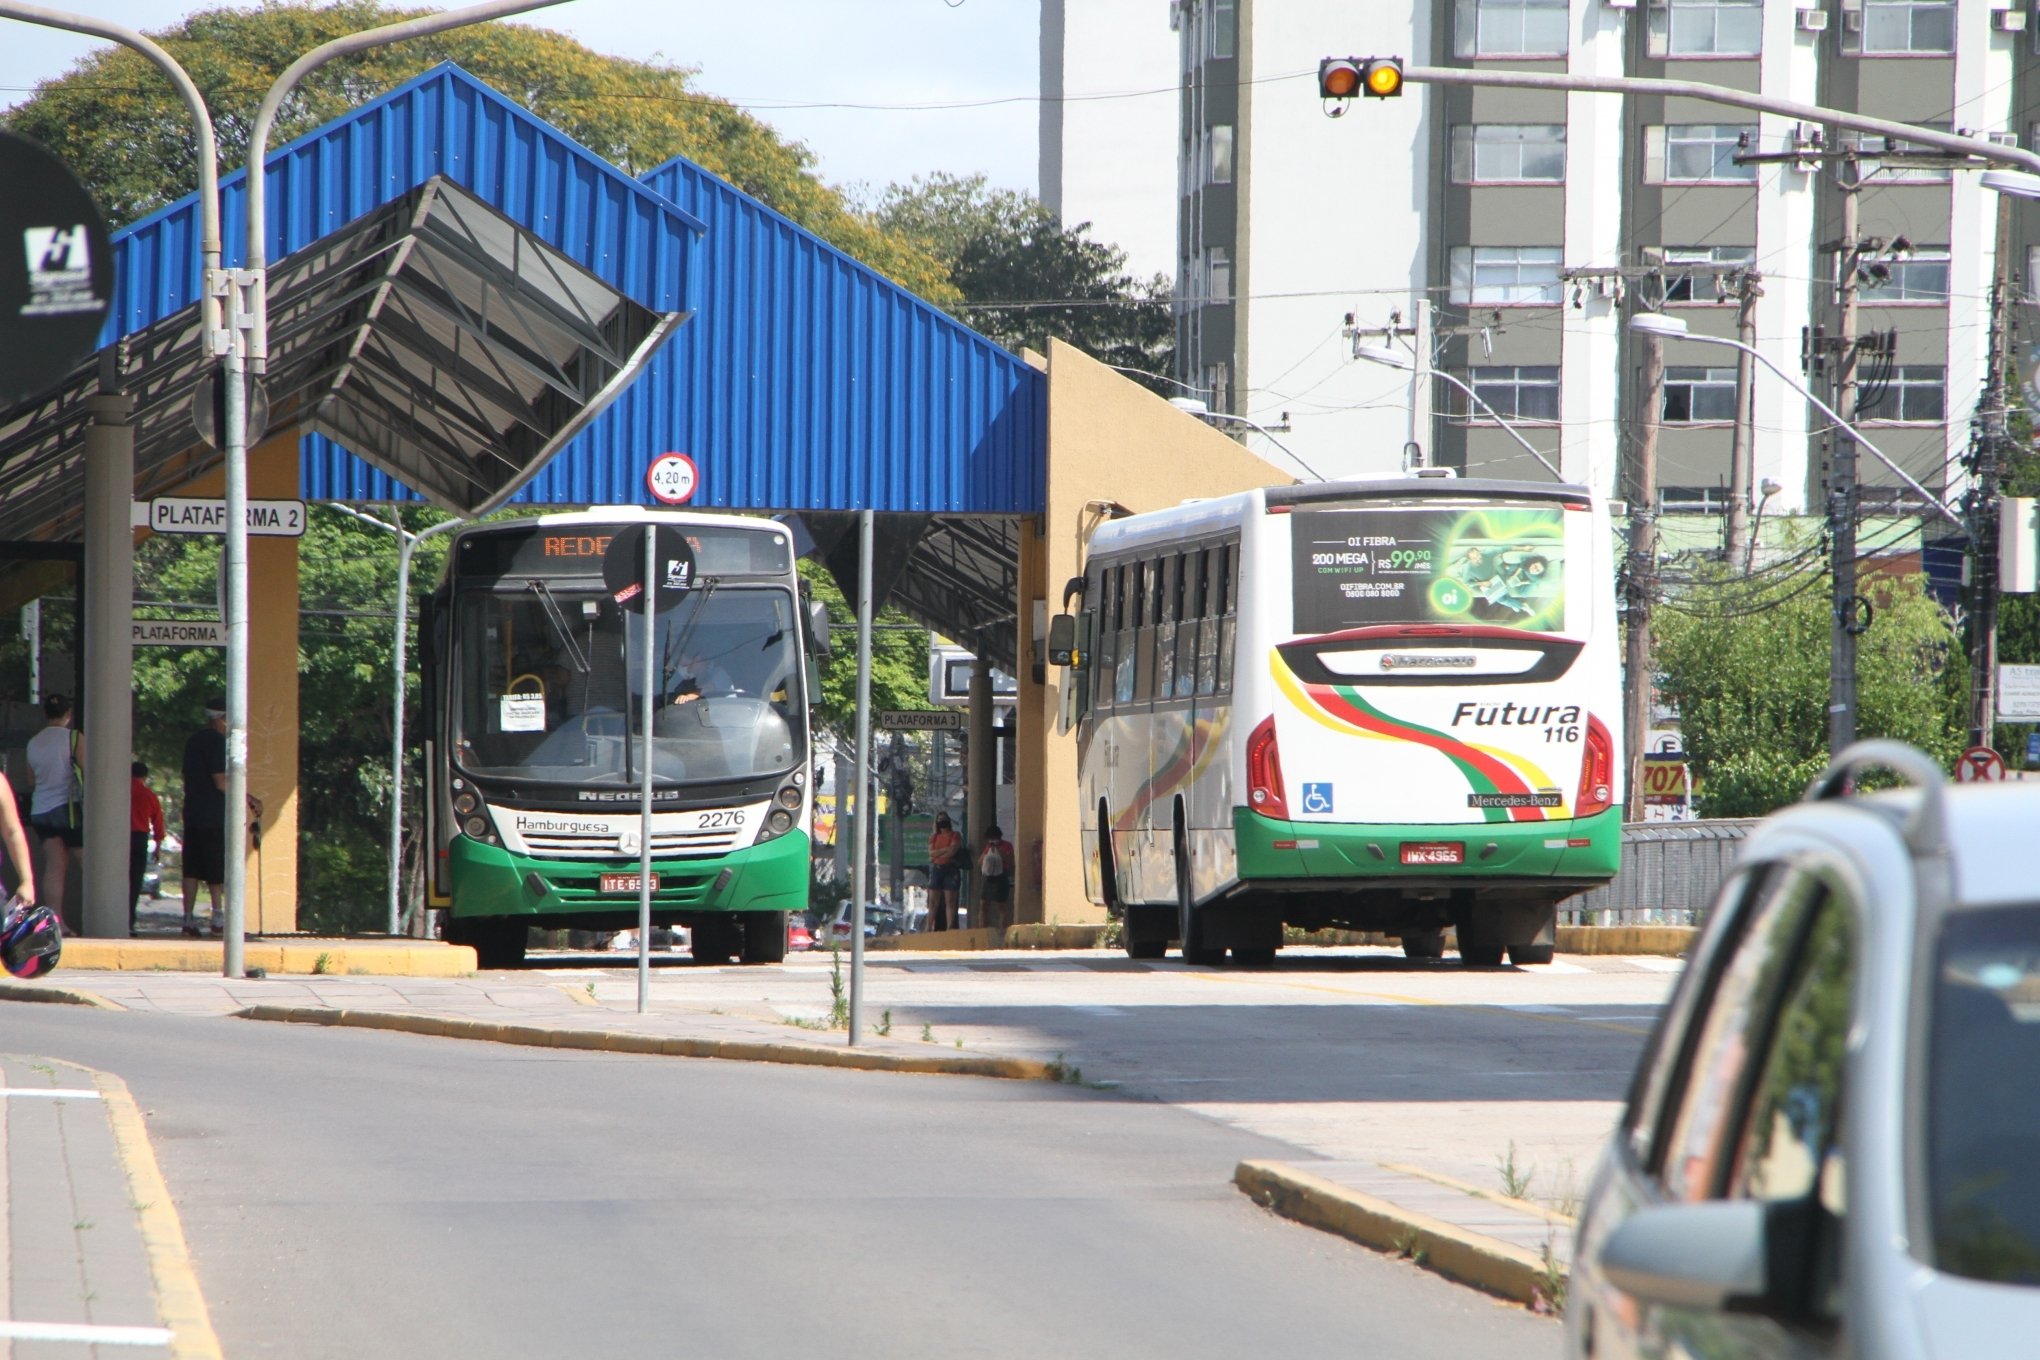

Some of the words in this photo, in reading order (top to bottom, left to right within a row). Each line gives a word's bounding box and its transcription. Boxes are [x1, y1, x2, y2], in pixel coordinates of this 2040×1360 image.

[289, 509, 298, 527] 2
[1363, 536, 1396, 546] FIBRA
[1312, 553, 1334, 565] 200
[1336, 553, 1368, 565] MEGA
[1442, 589, 1457, 605] oi
[132, 626, 217, 640] PLATAFORMA
[884, 714, 948, 726] PLATAFORMA
[950, 716, 956, 725] 3
[1451, 702, 1580, 726] Futura
[1544, 726, 1579, 742] 116
[1472, 796, 1558, 807] Mercedes-Benz
[516, 816, 609, 833] Hamburguesa
[698, 810, 745, 829] 2276
